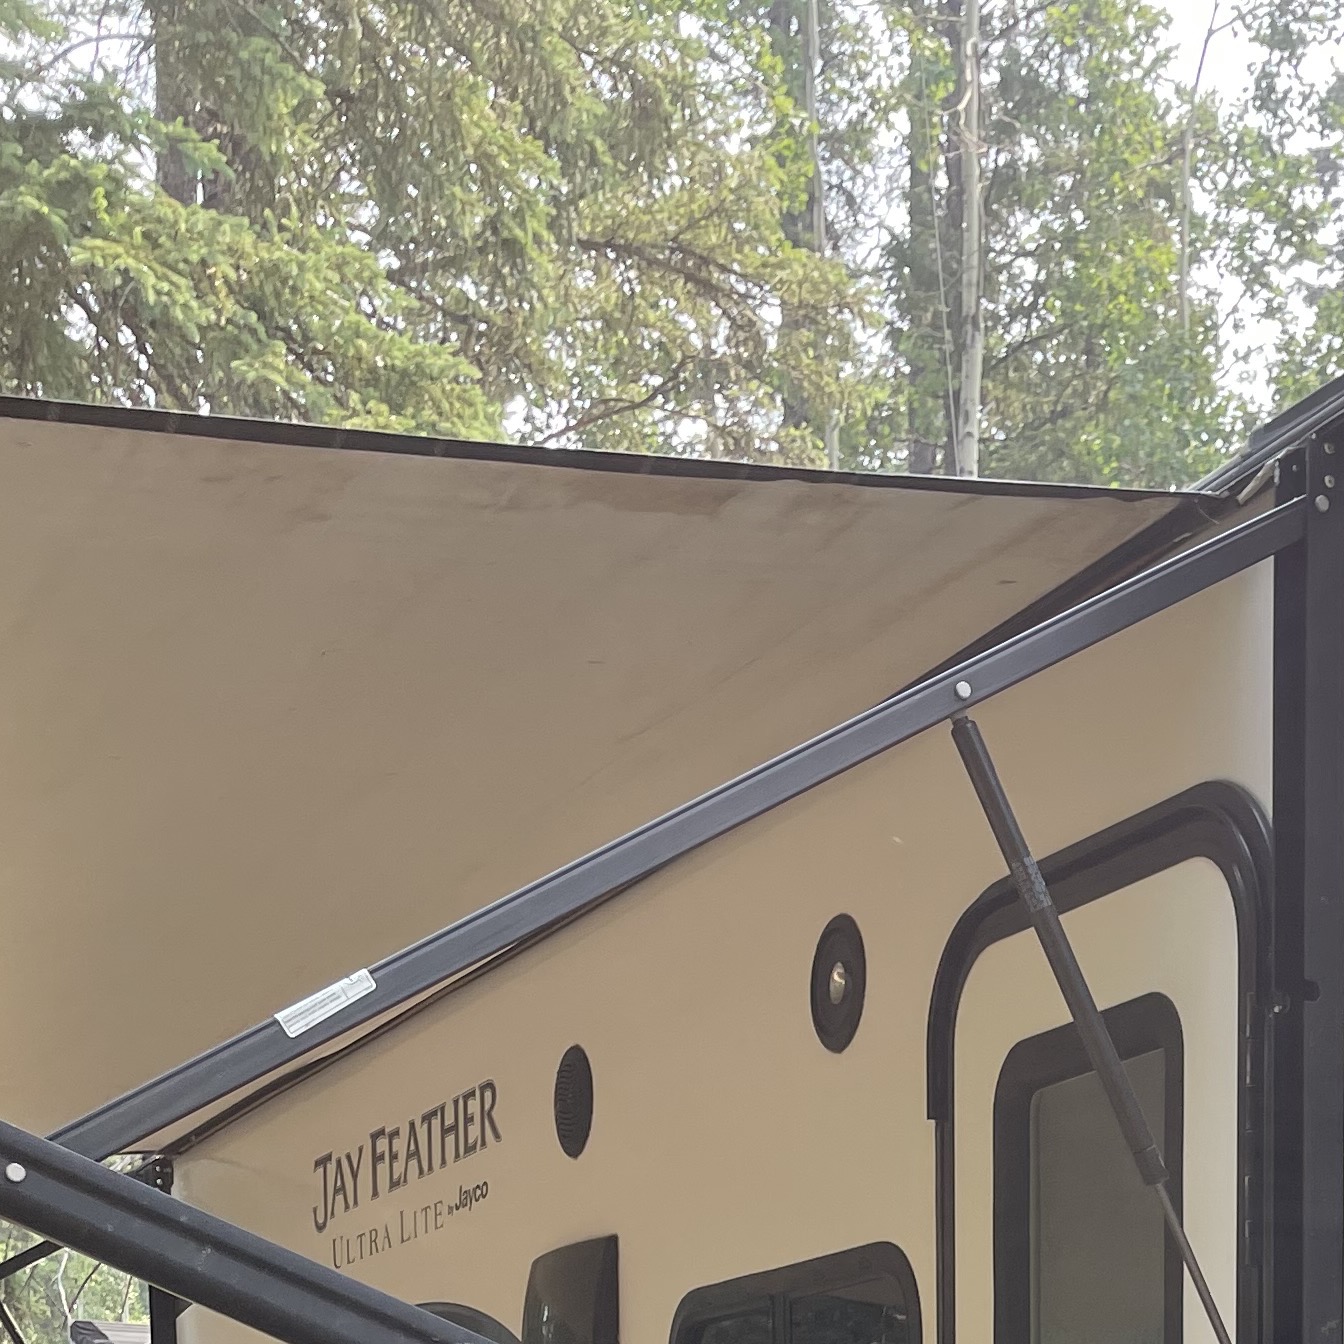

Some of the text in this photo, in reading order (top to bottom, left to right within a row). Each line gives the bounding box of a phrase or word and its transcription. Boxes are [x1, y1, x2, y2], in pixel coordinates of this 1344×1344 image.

[313, 1077, 503, 1233] JAY FEATHER
[332, 1223, 393, 1269] ULTRA
[400, 1200, 445, 1244] LITE
[455, 1181, 490, 1212] Jayco
